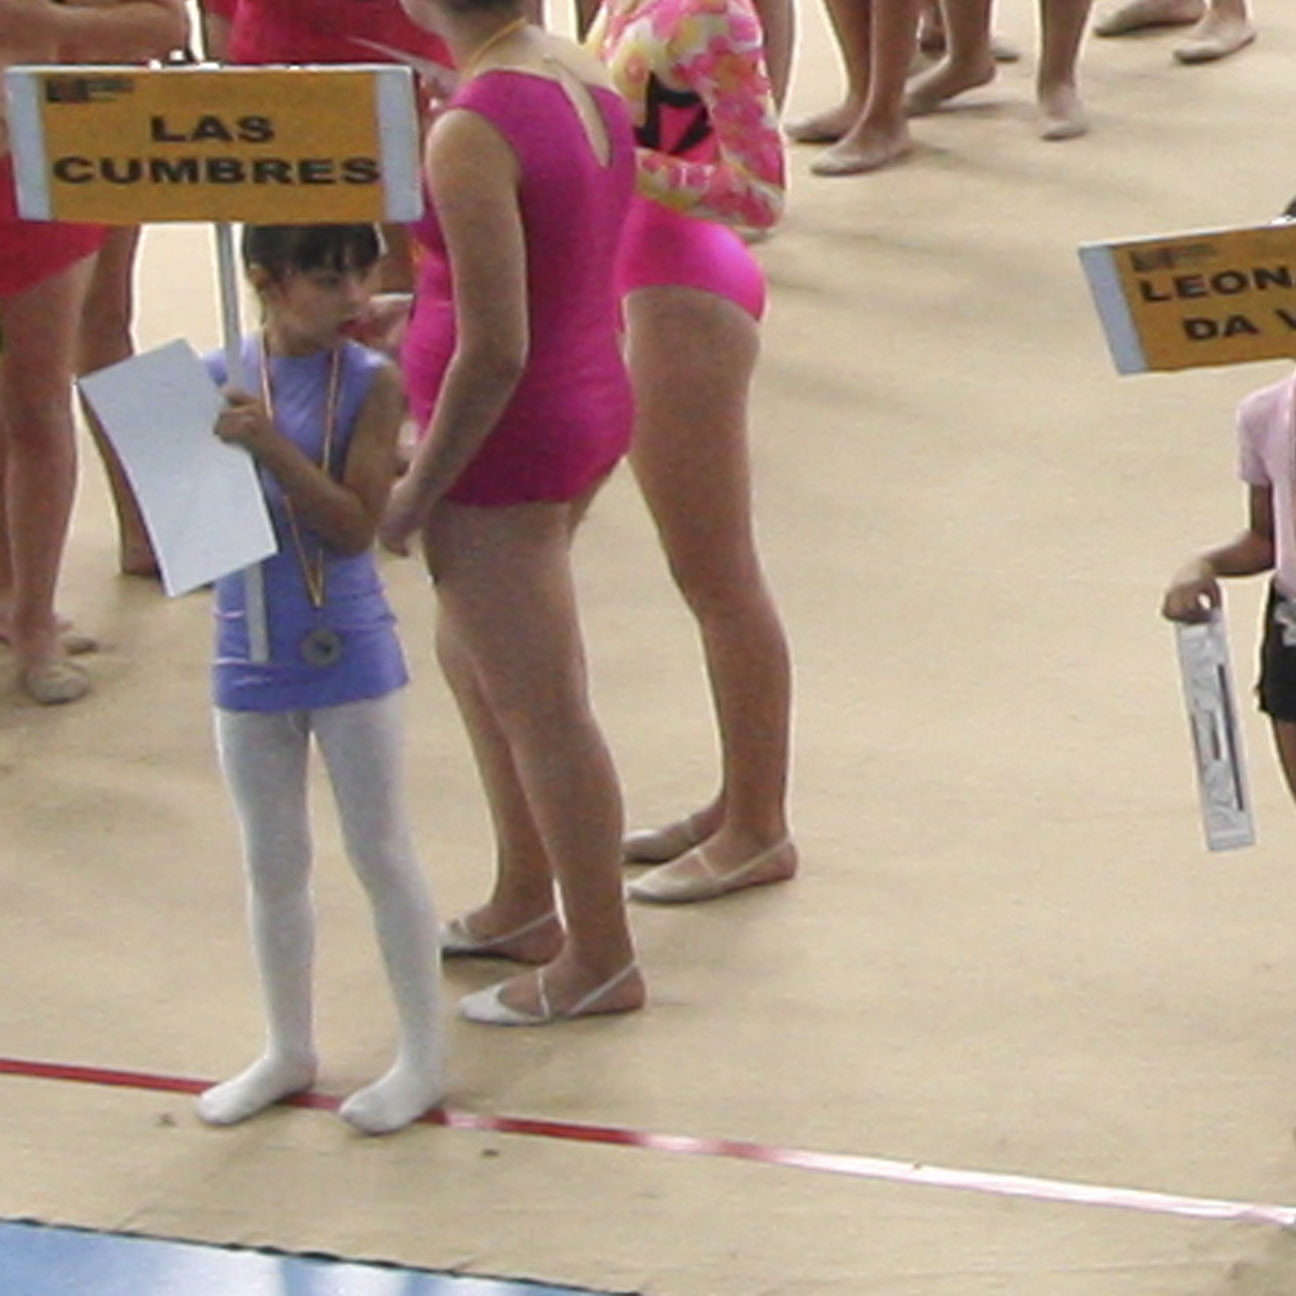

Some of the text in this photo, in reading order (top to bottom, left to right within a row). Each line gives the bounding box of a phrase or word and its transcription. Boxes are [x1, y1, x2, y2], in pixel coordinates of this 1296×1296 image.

[152, 115, 275, 143] LAS
[53, 155, 381, 185] CUMBRES
[1183, 314, 1260, 341] DA
